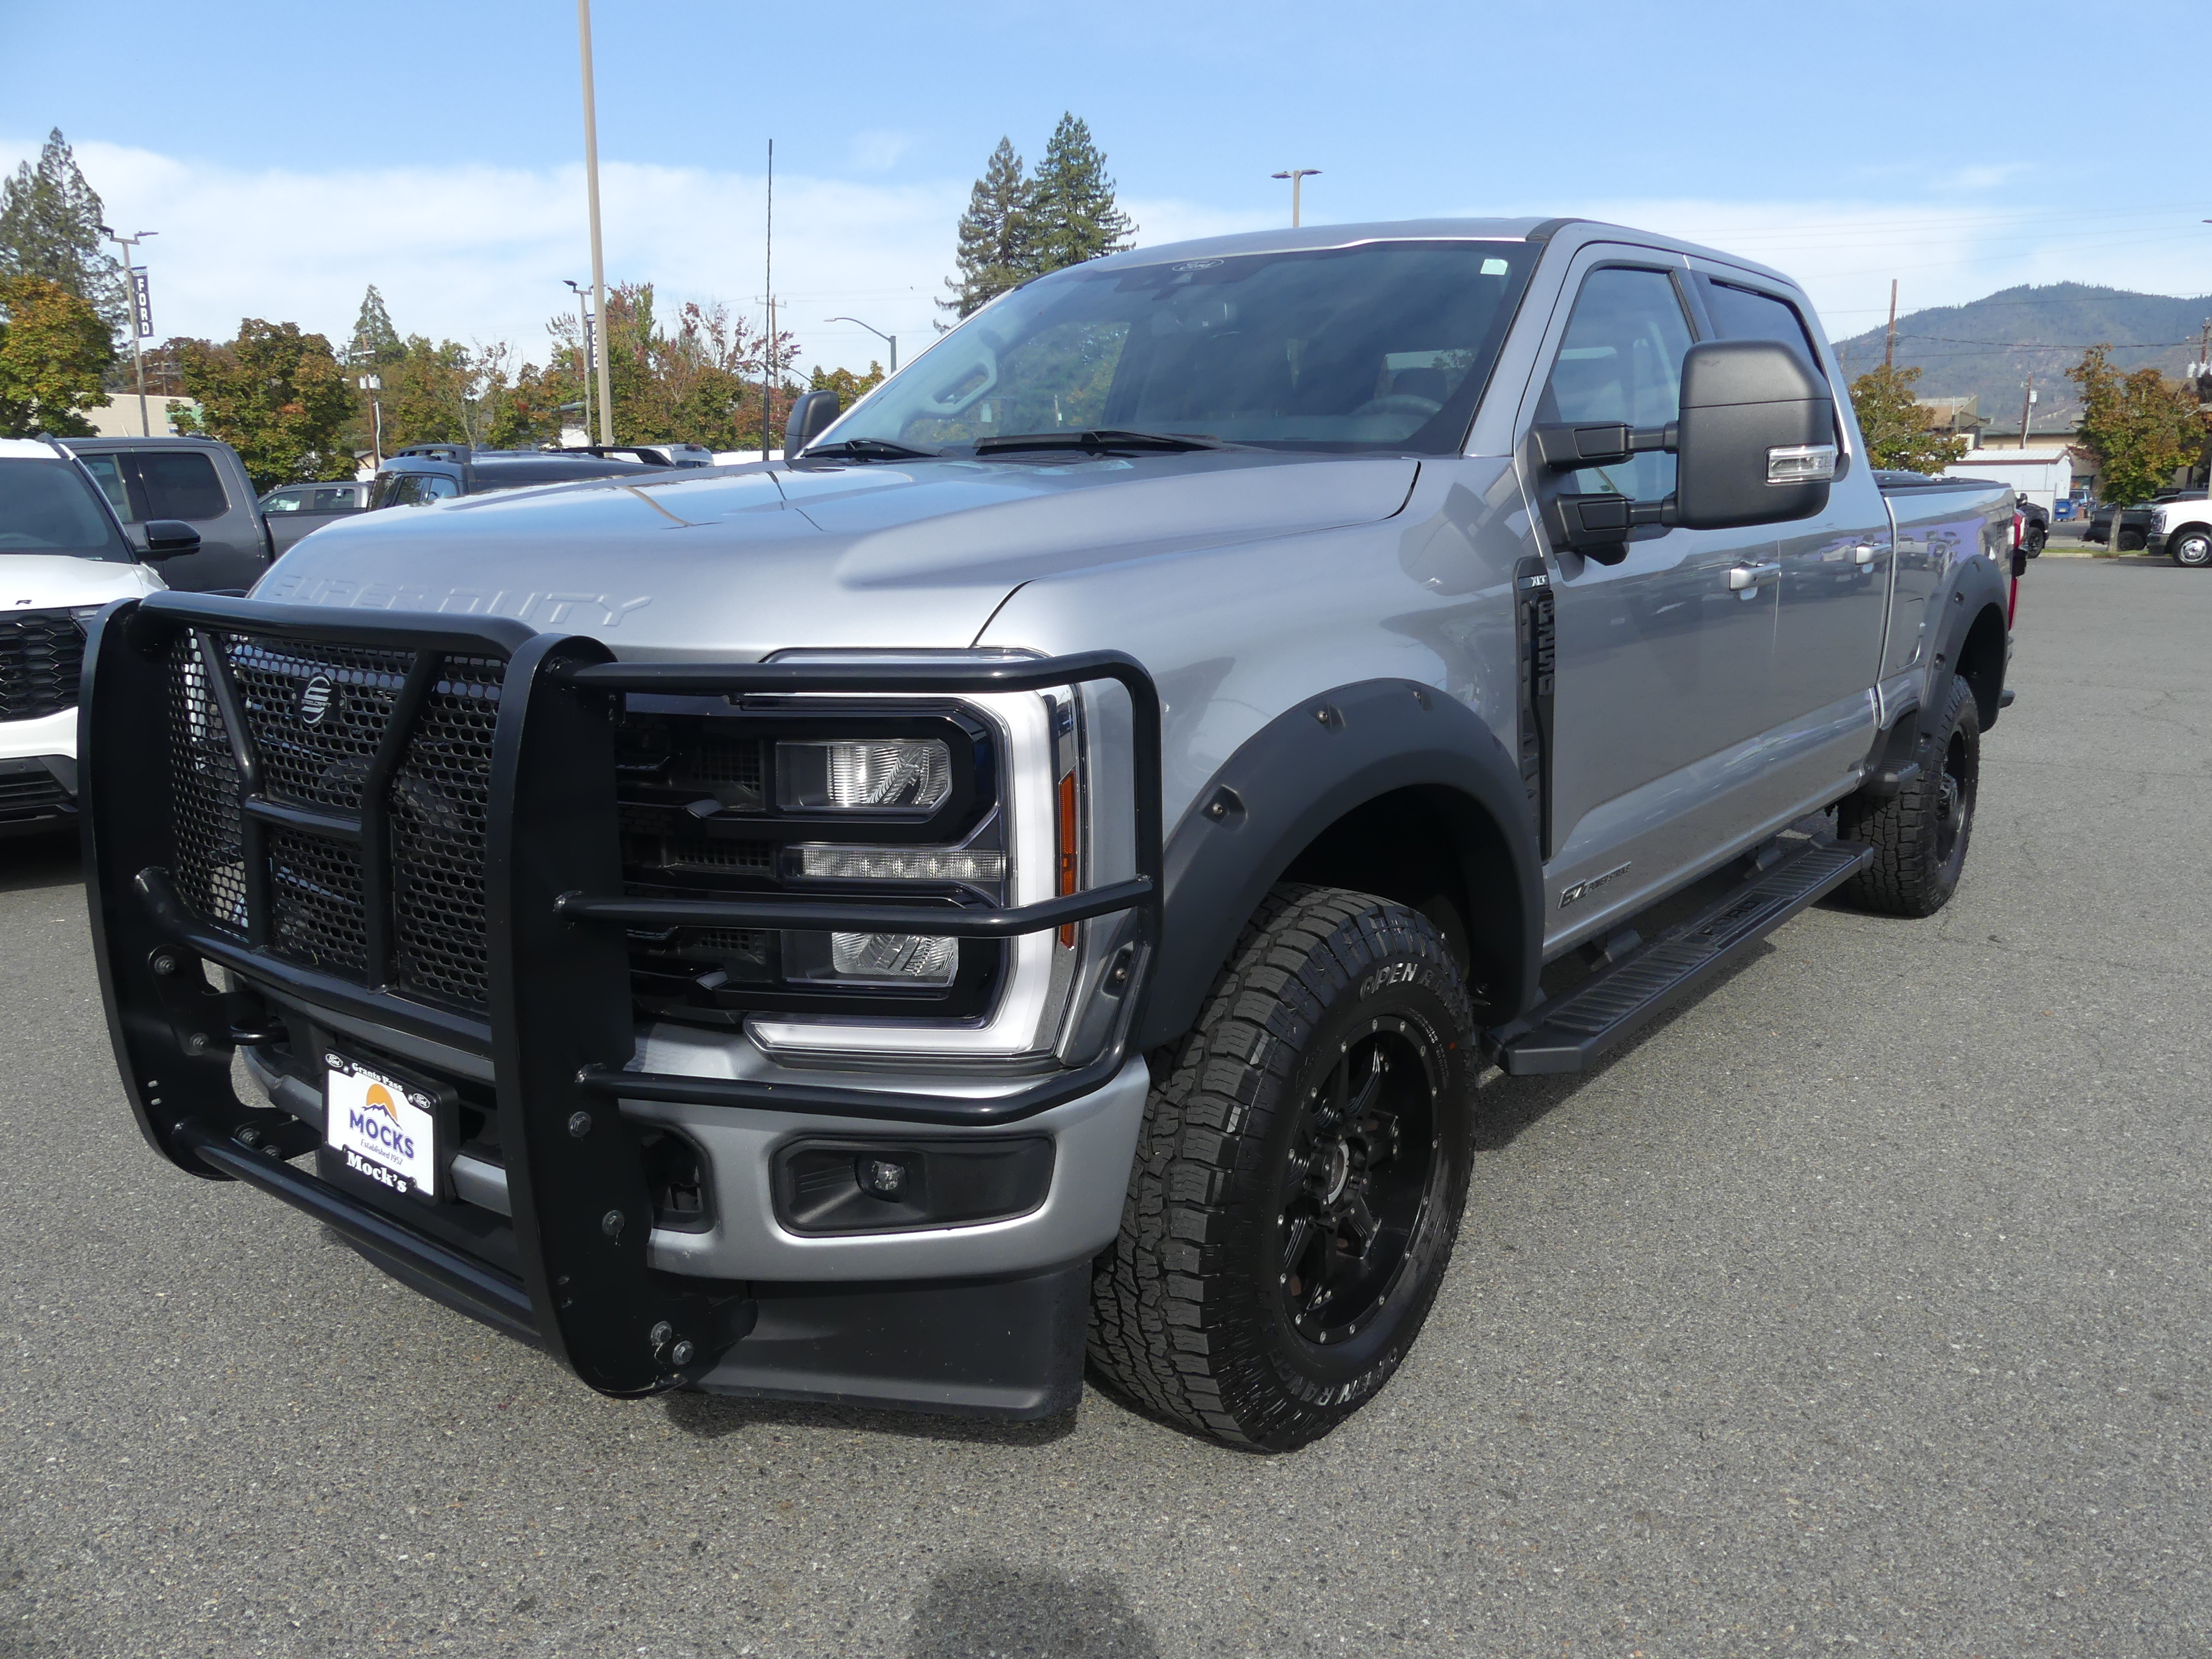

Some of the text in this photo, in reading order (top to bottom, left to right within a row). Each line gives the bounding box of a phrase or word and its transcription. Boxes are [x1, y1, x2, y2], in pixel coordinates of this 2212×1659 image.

[137, 278, 150, 335] FORD
[1530, 575, 1547, 587] XLT
[1359, 962, 1418, 1001] OPEN
[352, 1062, 403, 1092] Grants Pass
[349, 1108, 414, 1160] MOCKS
[361, 1139, 403, 1166] Established 1957
